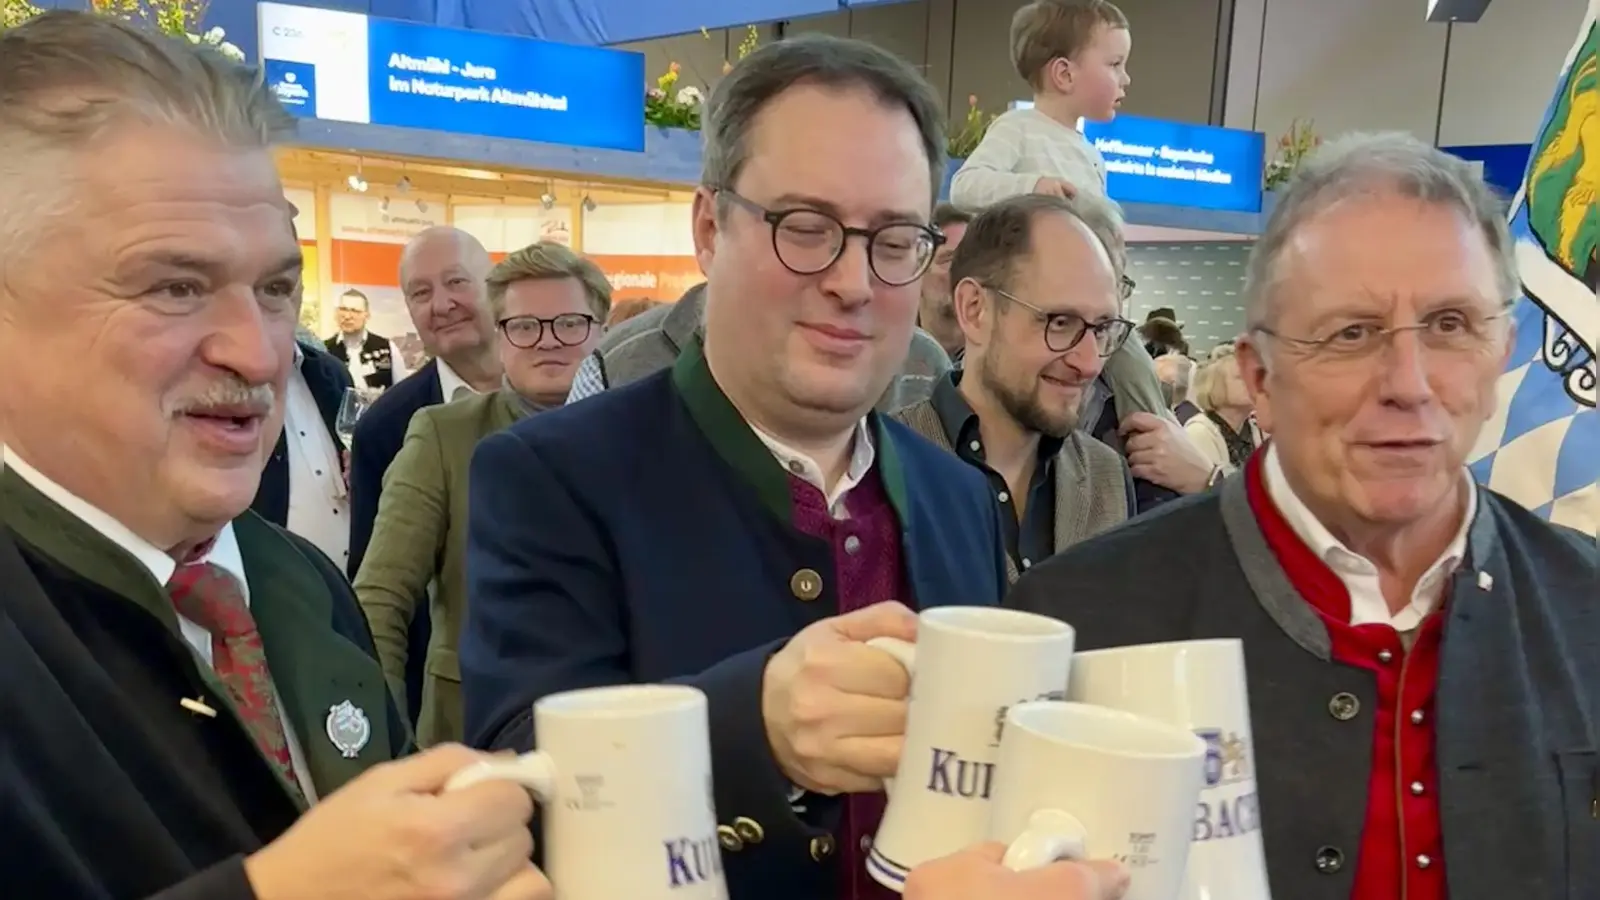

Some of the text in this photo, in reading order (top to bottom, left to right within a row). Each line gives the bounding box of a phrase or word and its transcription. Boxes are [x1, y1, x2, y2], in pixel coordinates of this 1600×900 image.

[272, 26, 281, 37] C
[460, 61, 496, 80] Jura
[412, 78, 490, 102] Naturpark
[604, 269, 657, 291] egionale
